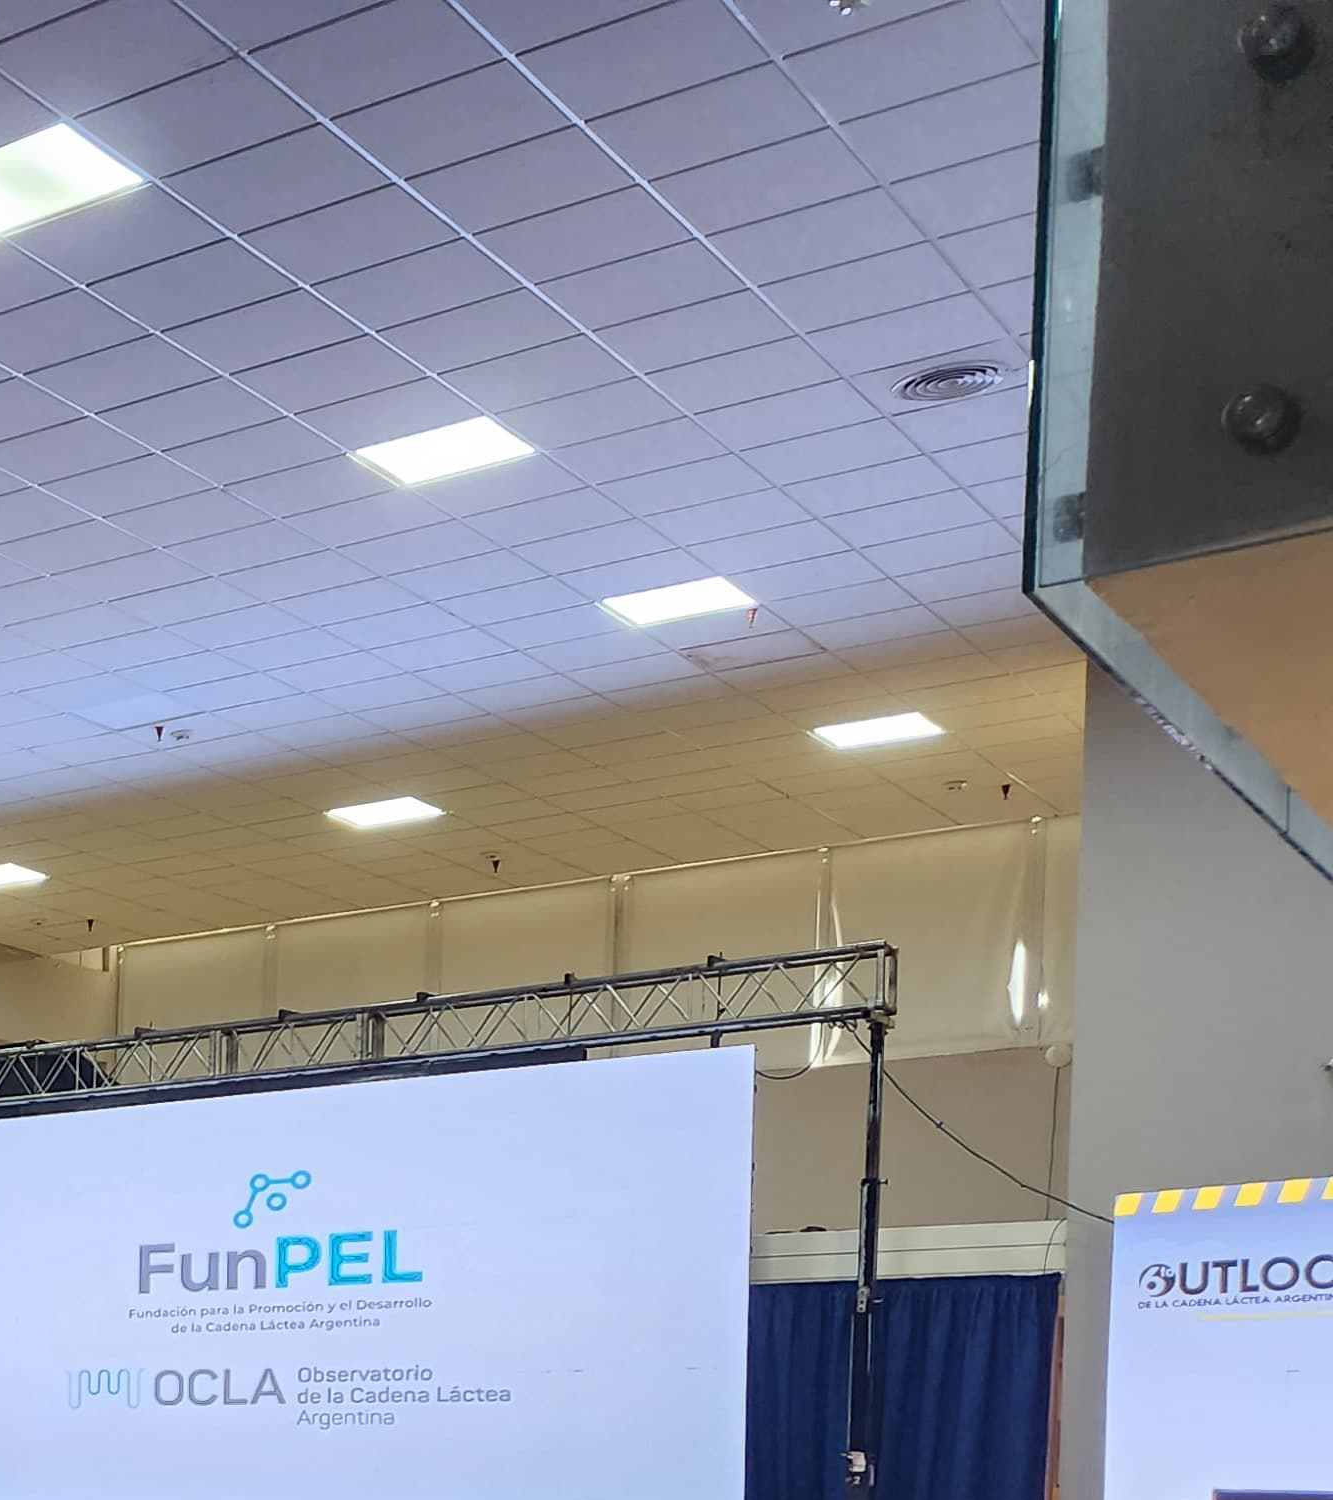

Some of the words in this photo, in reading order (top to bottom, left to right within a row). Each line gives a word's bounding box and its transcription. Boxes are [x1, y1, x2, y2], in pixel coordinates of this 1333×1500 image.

[138, 1229, 423, 1294] FunPEL
[128, 1305, 196, 1319] Fundación
[200, 1307, 229, 1318] para
[233, 1304, 244, 1314] la
[249, 1301, 324, 1314] Promoción
[327, 1303, 336, 1314] y
[339, 1299, 352, 1311] el
[356, 1297, 433, 1311] Desarrollo
[1137, 1301, 1151, 1309] DE
[1155, 1300, 1168, 1308] LA
[1172, 1299, 1221, 1307] CADENA
[1225, 1295, 1270, 1305] LÁCTEA
[171, 1323, 187, 1334] de
[191, 1322, 202, 1333] la
[206, 1320, 256, 1333] Cadena
[260, 1318, 305, 1331] Láctea
[309, 1316, 380, 1331] Argentina
[297, 1365, 433, 1383] Observatorio
[154, 1368, 286, 1406] OCLA
[297, 1388, 321, 1404] de
[327, 1387, 344, 1404] la
[350, 1386, 430, 1403] Cadena
[437, 1386, 511, 1402] Láctea
[297, 1409, 395, 1430] Argentina
